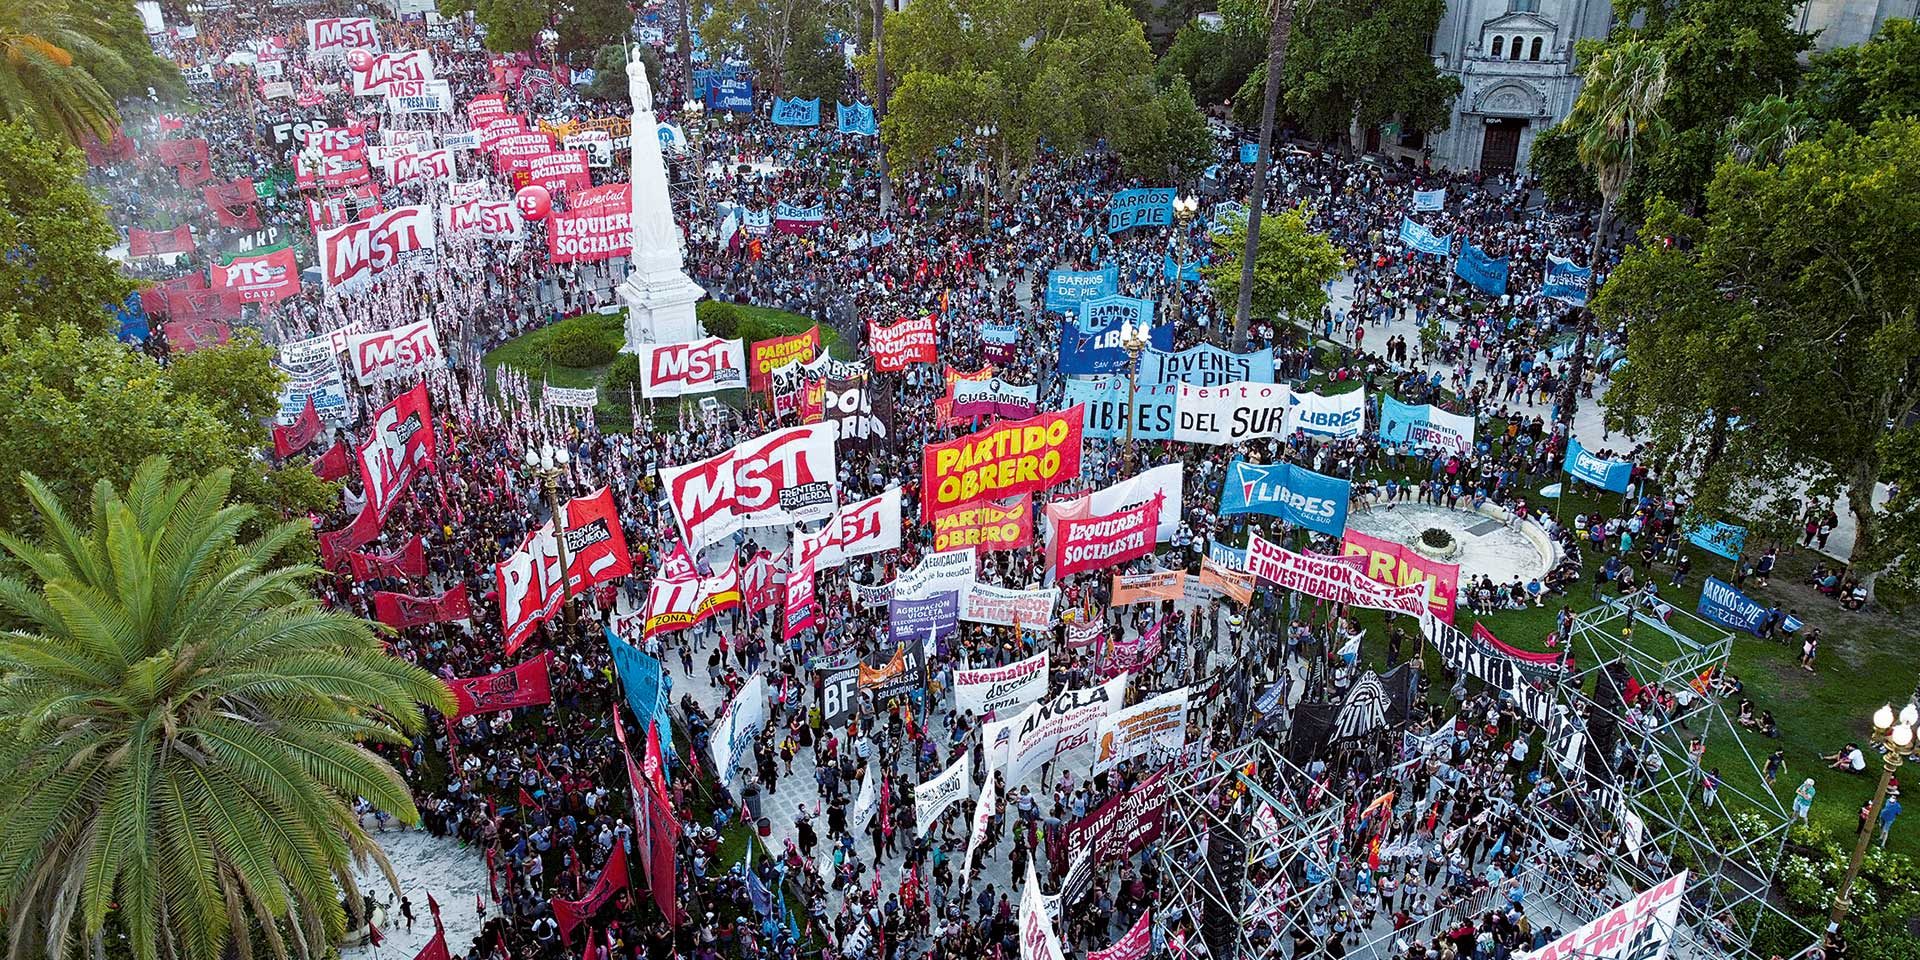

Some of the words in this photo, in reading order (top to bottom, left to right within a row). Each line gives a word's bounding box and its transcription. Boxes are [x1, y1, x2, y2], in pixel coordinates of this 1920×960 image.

[318, 23, 373, 49] MST
[370, 58, 425, 83] MST
[390, 82, 424, 97] MST
[425, 97, 440, 109] VIVE
[309, 130, 350, 149] PTS
[397, 152, 447, 180] MST
[531, 163, 584, 180] SOCIALISTA
[546, 179, 567, 190] SUR
[573, 186, 628, 210] Juventud
[1113, 193, 1170, 209] BARRIOS
[455, 205, 514, 236] MST
[555, 215, 633, 238] IZQUIER
[1111, 214, 1132, 229] DE
[1135, 208, 1165, 223] PIE
[333, 216, 424, 279] MST
[557, 232, 634, 255] SOCIALIS
[226, 261, 270, 287] PTS
[1057, 275, 1104, 288] BARRIOS
[1058, 287, 1076, 297] DE
[1080, 287, 1097, 297] PIE
[1090, 305, 1139, 319] BARRIOS
[870, 319, 933, 343] IZQUIERDA
[364, 334, 434, 372] MST
[757, 334, 812, 361] PARTIDO
[870, 332, 935, 358] SOCIALISTA
[657, 346, 732, 381] MST
[1180, 411, 1220, 433] DEL
[1230, 406, 1285, 438] SUR
[1300, 407, 1361, 427] LIBRES
[936, 419, 1071, 479] PARTIDO
[1405, 422, 1442, 446] LIBRES
[1442, 436, 1456, 448] DEL
[1455, 434, 1472, 456] SUR
[362, 405, 408, 511] PTS
[681, 440, 806, 522] MST
[937, 450, 1062, 504] OBRERO
[779, 484, 815, 502] FRENTE
[815, 482, 828, 493] DE
[780, 490, 831, 507] IZQUIERDA
[1258, 482, 1337, 519] LIBRES
[795, 507, 820, 520] UNIDAD
[936, 503, 1025, 533] PARTIDO
[1318, 514, 1332, 525] SUR
[567, 522, 594, 543] FRENTE
[569, 527, 611, 551] IZQUIERDA
[808, 505, 882, 556] MST
[936, 522, 1021, 552] OBRERO
[1067, 511, 1145, 545] IZQUIERDA
[1063, 531, 1146, 567] SOCIALISTA
[1252, 537, 1352, 587] SUSPENSION
[501, 503, 577, 632] PTS
[790, 576, 813, 605] PTS
[1250, 556, 1258, 572] E
[1259, 560, 1357, 606] INVESTIGACION
[896, 601, 951, 616] AGRUPACIÓN
[1703, 578, 1740, 612] BARRIOS
[1743, 603, 1765, 625] PIE
[655, 613, 689, 627] ZONA
[896, 624, 914, 634] MAC
[907, 610, 943, 622] VIOLETA
[1430, 613, 1515, 692] LIBERTAD
[956, 655, 1046, 687] Alternativa
[824, 677, 857, 721] BF
[983, 697, 1020, 713] CAPITAL
[1017, 686, 1110, 744] ANCLA
